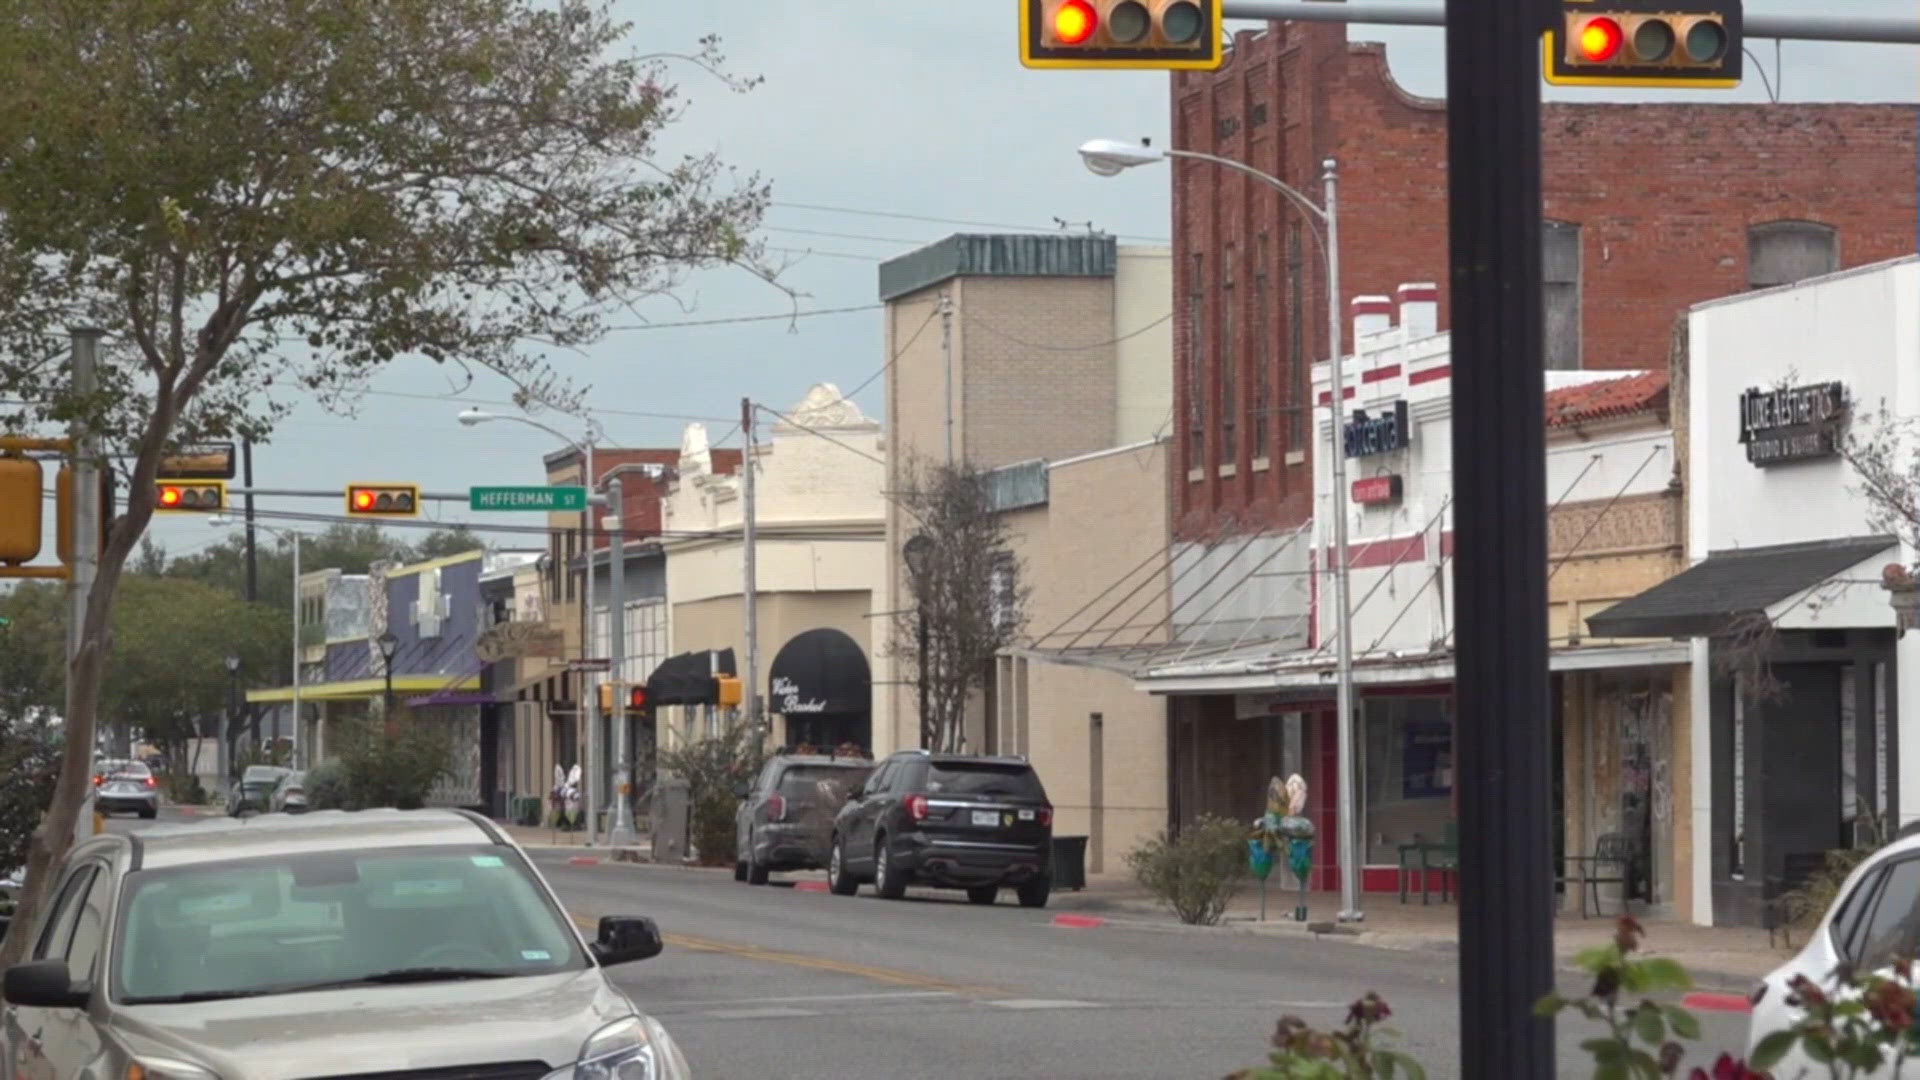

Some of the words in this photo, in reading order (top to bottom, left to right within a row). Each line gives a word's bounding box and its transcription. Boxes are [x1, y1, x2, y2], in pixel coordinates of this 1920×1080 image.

[1744, 388, 1771, 431] LUXE
[1772, 385, 1833, 426] AESTHETICS
[1751, 438, 1779, 460] STUDIO
[480, 491, 554, 506] HEFFERMAN
[563, 494, 576, 506] ST
[780, 694, 827, 713] Basket
